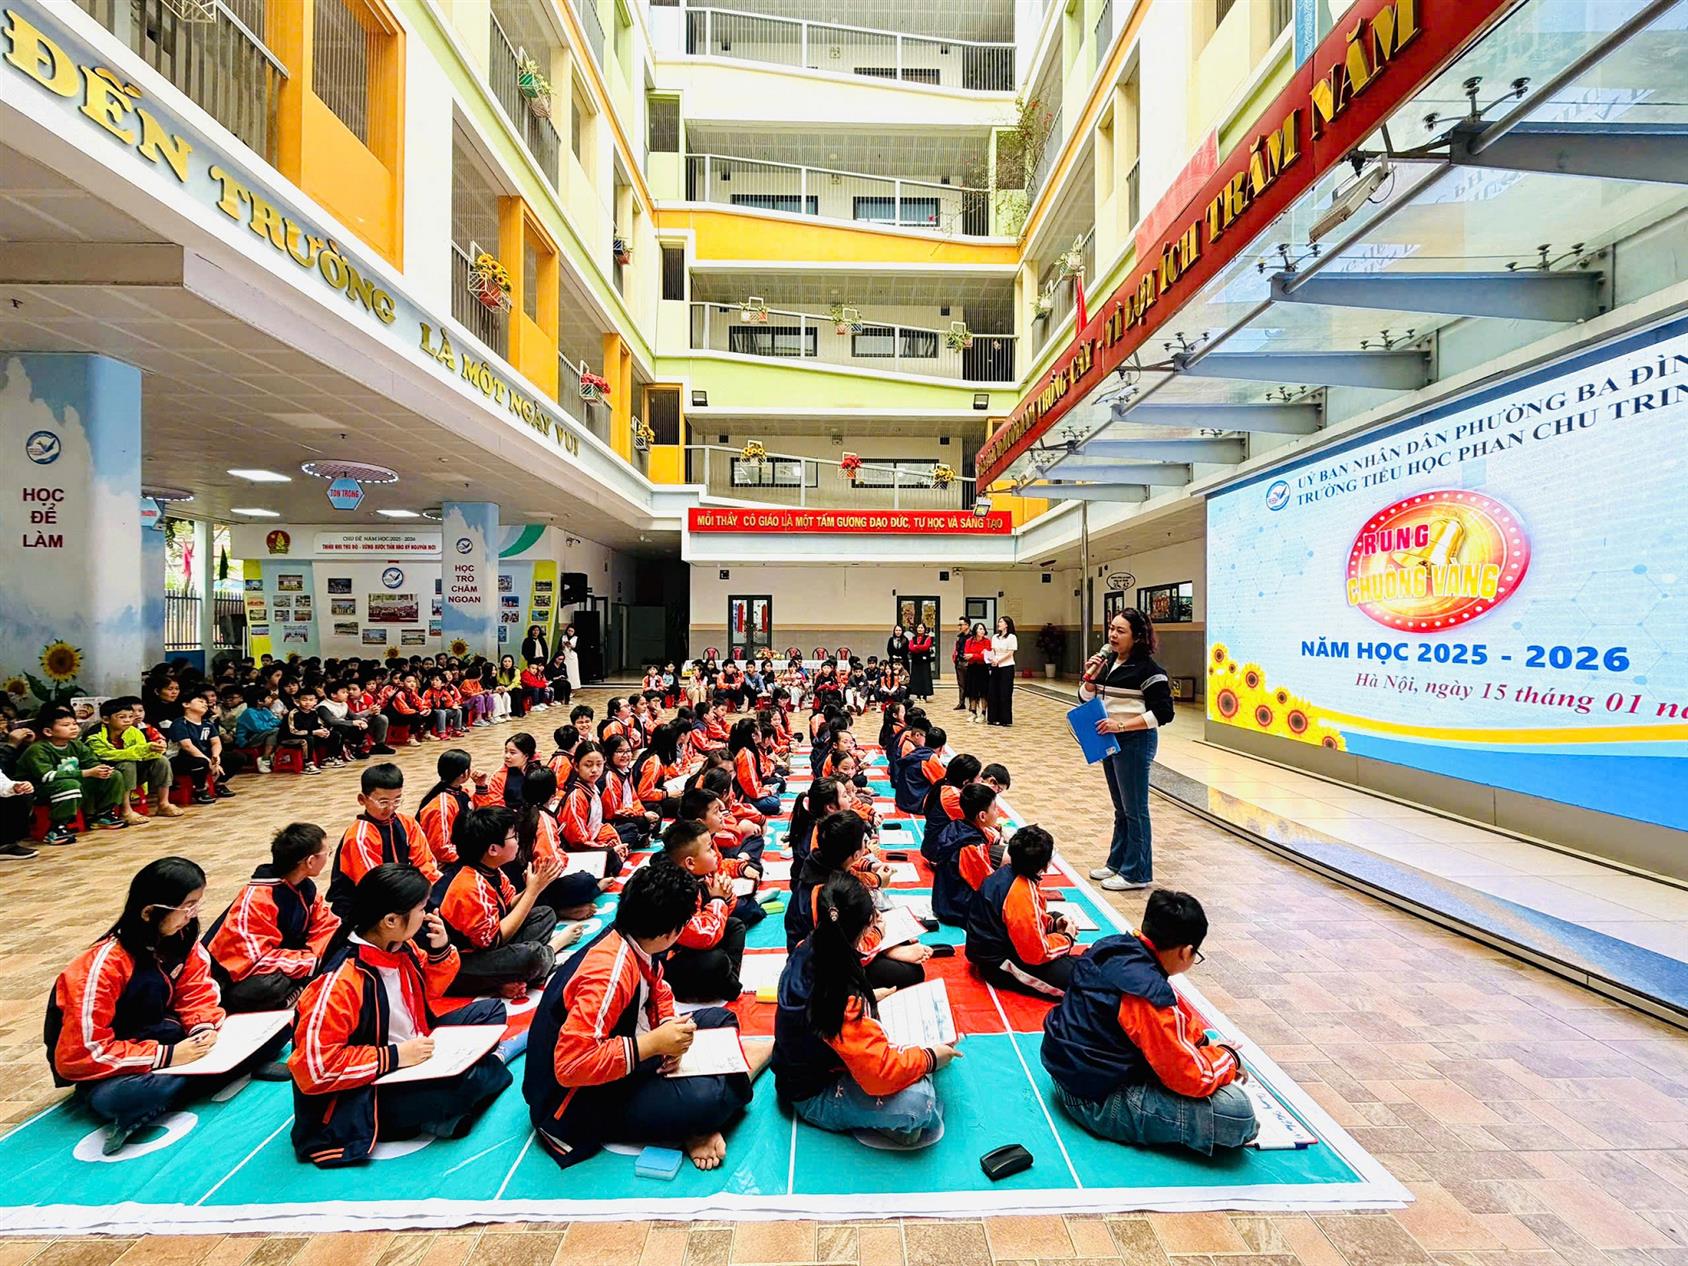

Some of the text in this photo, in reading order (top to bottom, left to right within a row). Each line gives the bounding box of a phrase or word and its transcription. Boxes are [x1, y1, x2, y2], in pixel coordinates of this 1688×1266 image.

[1070, 337, 1095, 384] CÂY
[1105, 301, 1123, 348] VÌ
[1125, 268, 1157, 331] LỢI
[1160, 220, 1201, 295] ÍCH
[1205, 108, 1302, 244] TRĂM
[1309, 0, 1422, 141] NĂM
[2, 9, 581, 456] ĐẾN TRƯỜNG LÀ MỘT NGÀY VUI
[1320, 462, 1349, 482] BAN
[1354, 446, 1400, 470] NHÂN
[1407, 431, 1448, 455] DÂN
[1456, 392, 1567, 441] PHƯỜNG
[1576, 377, 1619, 403] BA
[1297, 479, 1357, 506] TRƯỜNG
[1361, 462, 1402, 488] TIỂU
[1407, 451, 1452, 475] HỌC
[1458, 430, 1526, 462] PHAN
[1533, 408, 1600, 441] CHU
[23, 488, 64, 506] HỌC
[31, 503, 57, 524] ĐỂ
[743, 512, 757, 526] CÔ
[758, 512, 779, 526] GIÁO
[781, 512, 793, 527] LÀ
[795, 514, 814, 528] MỘT
[816, 512, 835, 527] TẤM
[836, 515, 867, 527] GƯƠNG
[869, 517, 888, 530] ĐẠO
[914, 517, 925, 530] TỰ
[928, 518, 945, 530] HỌC
[947, 514, 958, 528] VÀ
[960, 514, 984, 528] SÁNG
[986, 518, 1003, 530] TẠO
[23, 530, 63, 548] LÀM
[1363, 524, 1429, 555] RUNG
[455, 565, 474, 573] HỌC
[456, 573, 474, 582] TRÒ
[1431, 558, 1499, 600] VÀNG
[1301, 636, 1349, 658] NĂM
[1357, 642, 1409, 664] HỌC
[1417, 643, 1488, 665] 2025
[1525, 645, 1630, 672] 2026
[1354, 673, 1378, 688] Hà
[1383, 675, 1418, 693] Nội,
[1425, 680, 1473, 700] ngày
[1481, 683, 1507, 701] 15
[1515, 686, 1596, 715] tháng
[1605, 692, 1642, 714] 01
